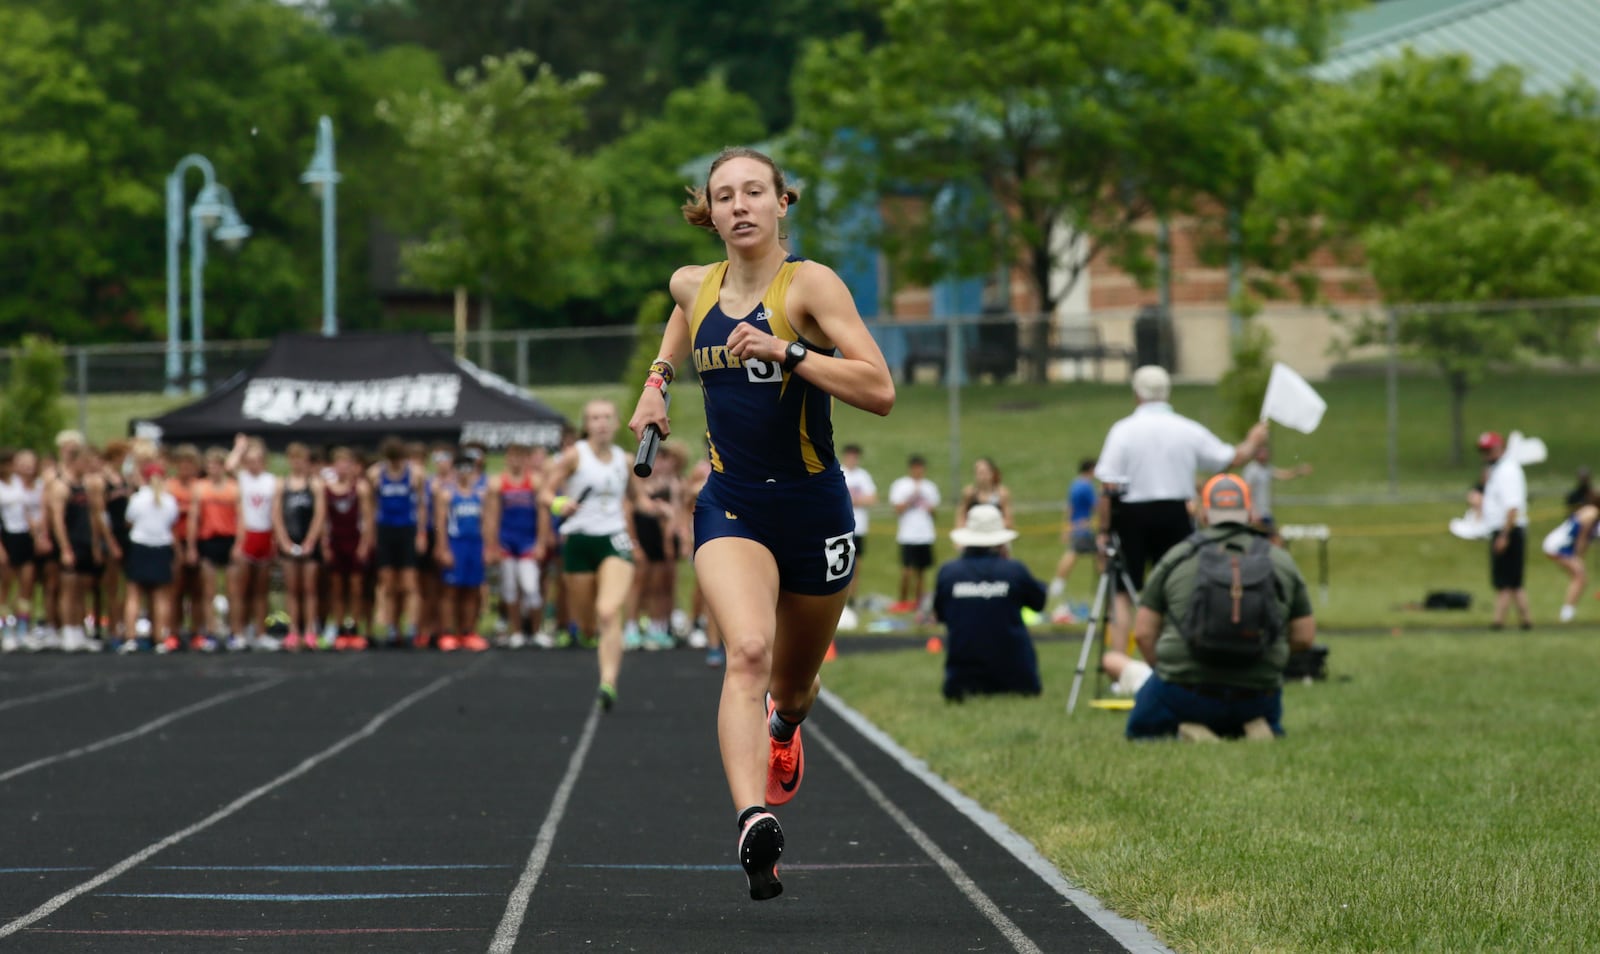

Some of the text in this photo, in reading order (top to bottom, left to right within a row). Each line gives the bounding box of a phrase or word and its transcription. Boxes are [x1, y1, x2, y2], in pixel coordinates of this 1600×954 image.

[694, 345, 747, 373] OAKW
[243, 376, 459, 421] PANTHERS
[829, 538, 851, 576] 3
